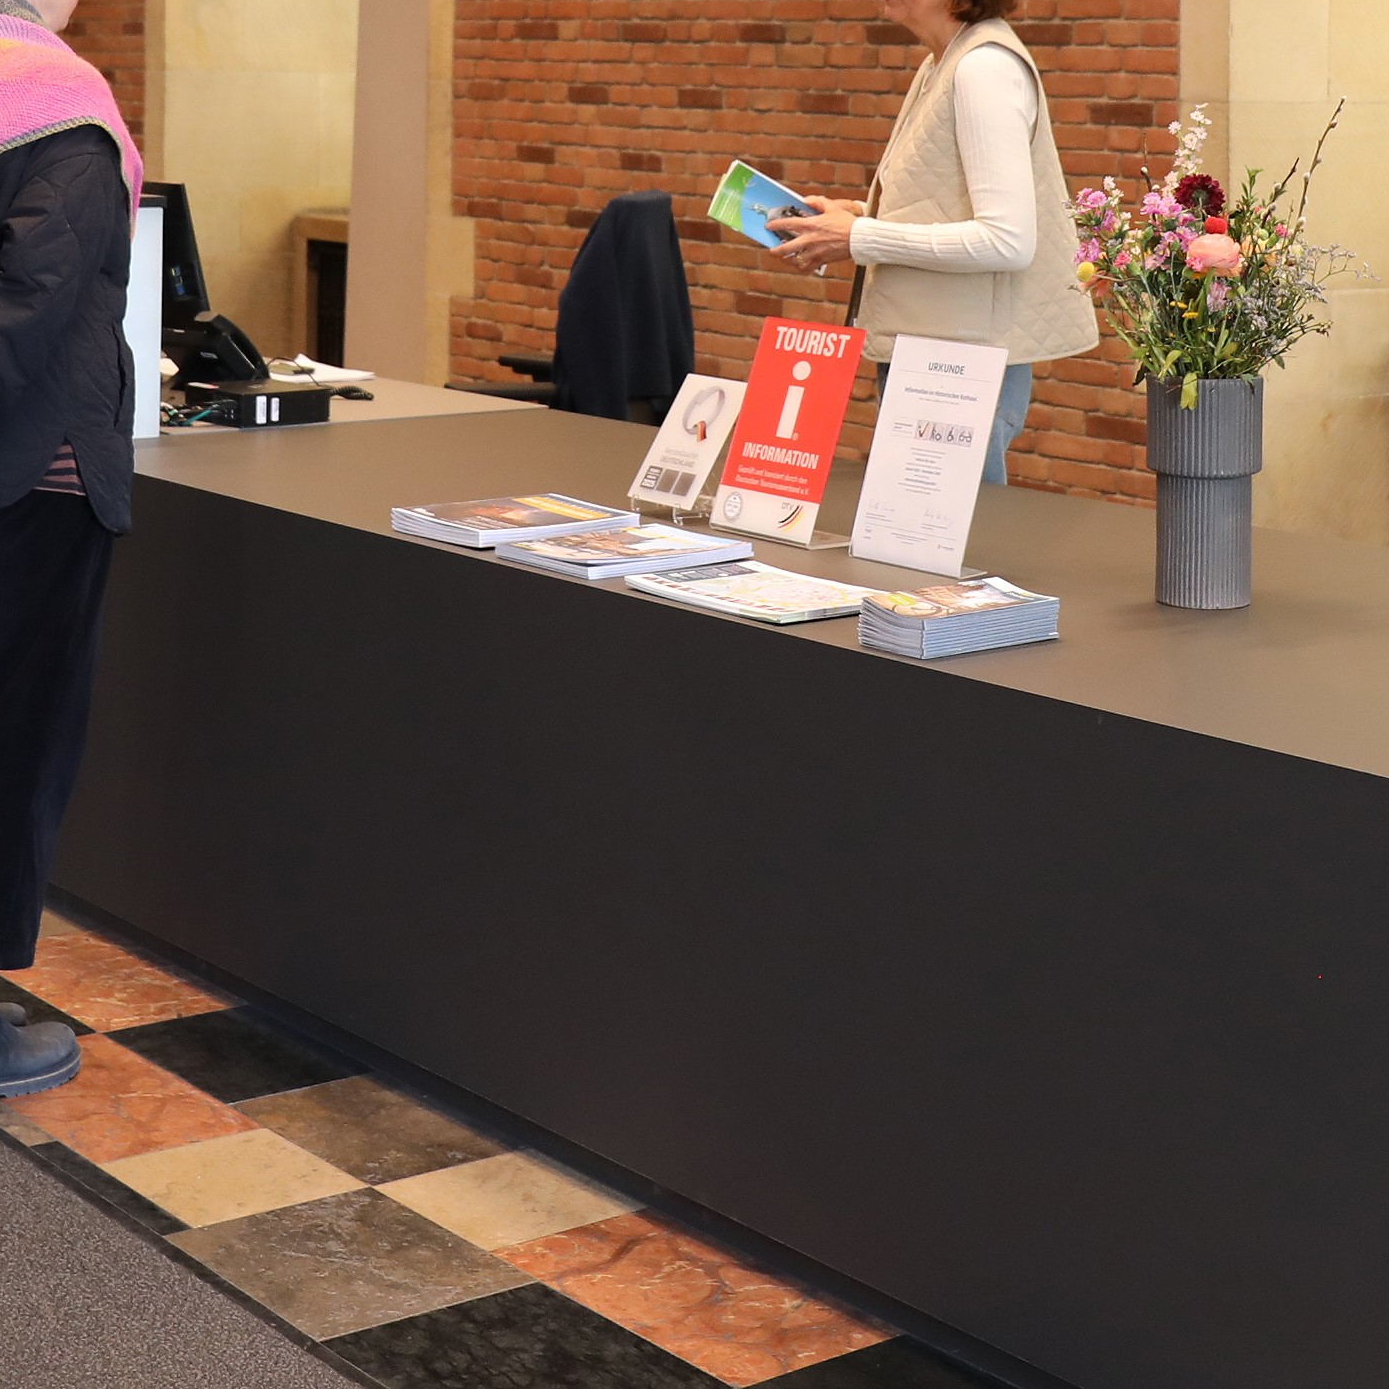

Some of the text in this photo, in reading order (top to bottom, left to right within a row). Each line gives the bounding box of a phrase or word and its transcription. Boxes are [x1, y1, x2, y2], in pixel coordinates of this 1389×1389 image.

[775, 326, 851, 358] TOURIST
[928, 362, 965, 375] URKUNDE
[742, 442, 820, 470] INFORMATION
